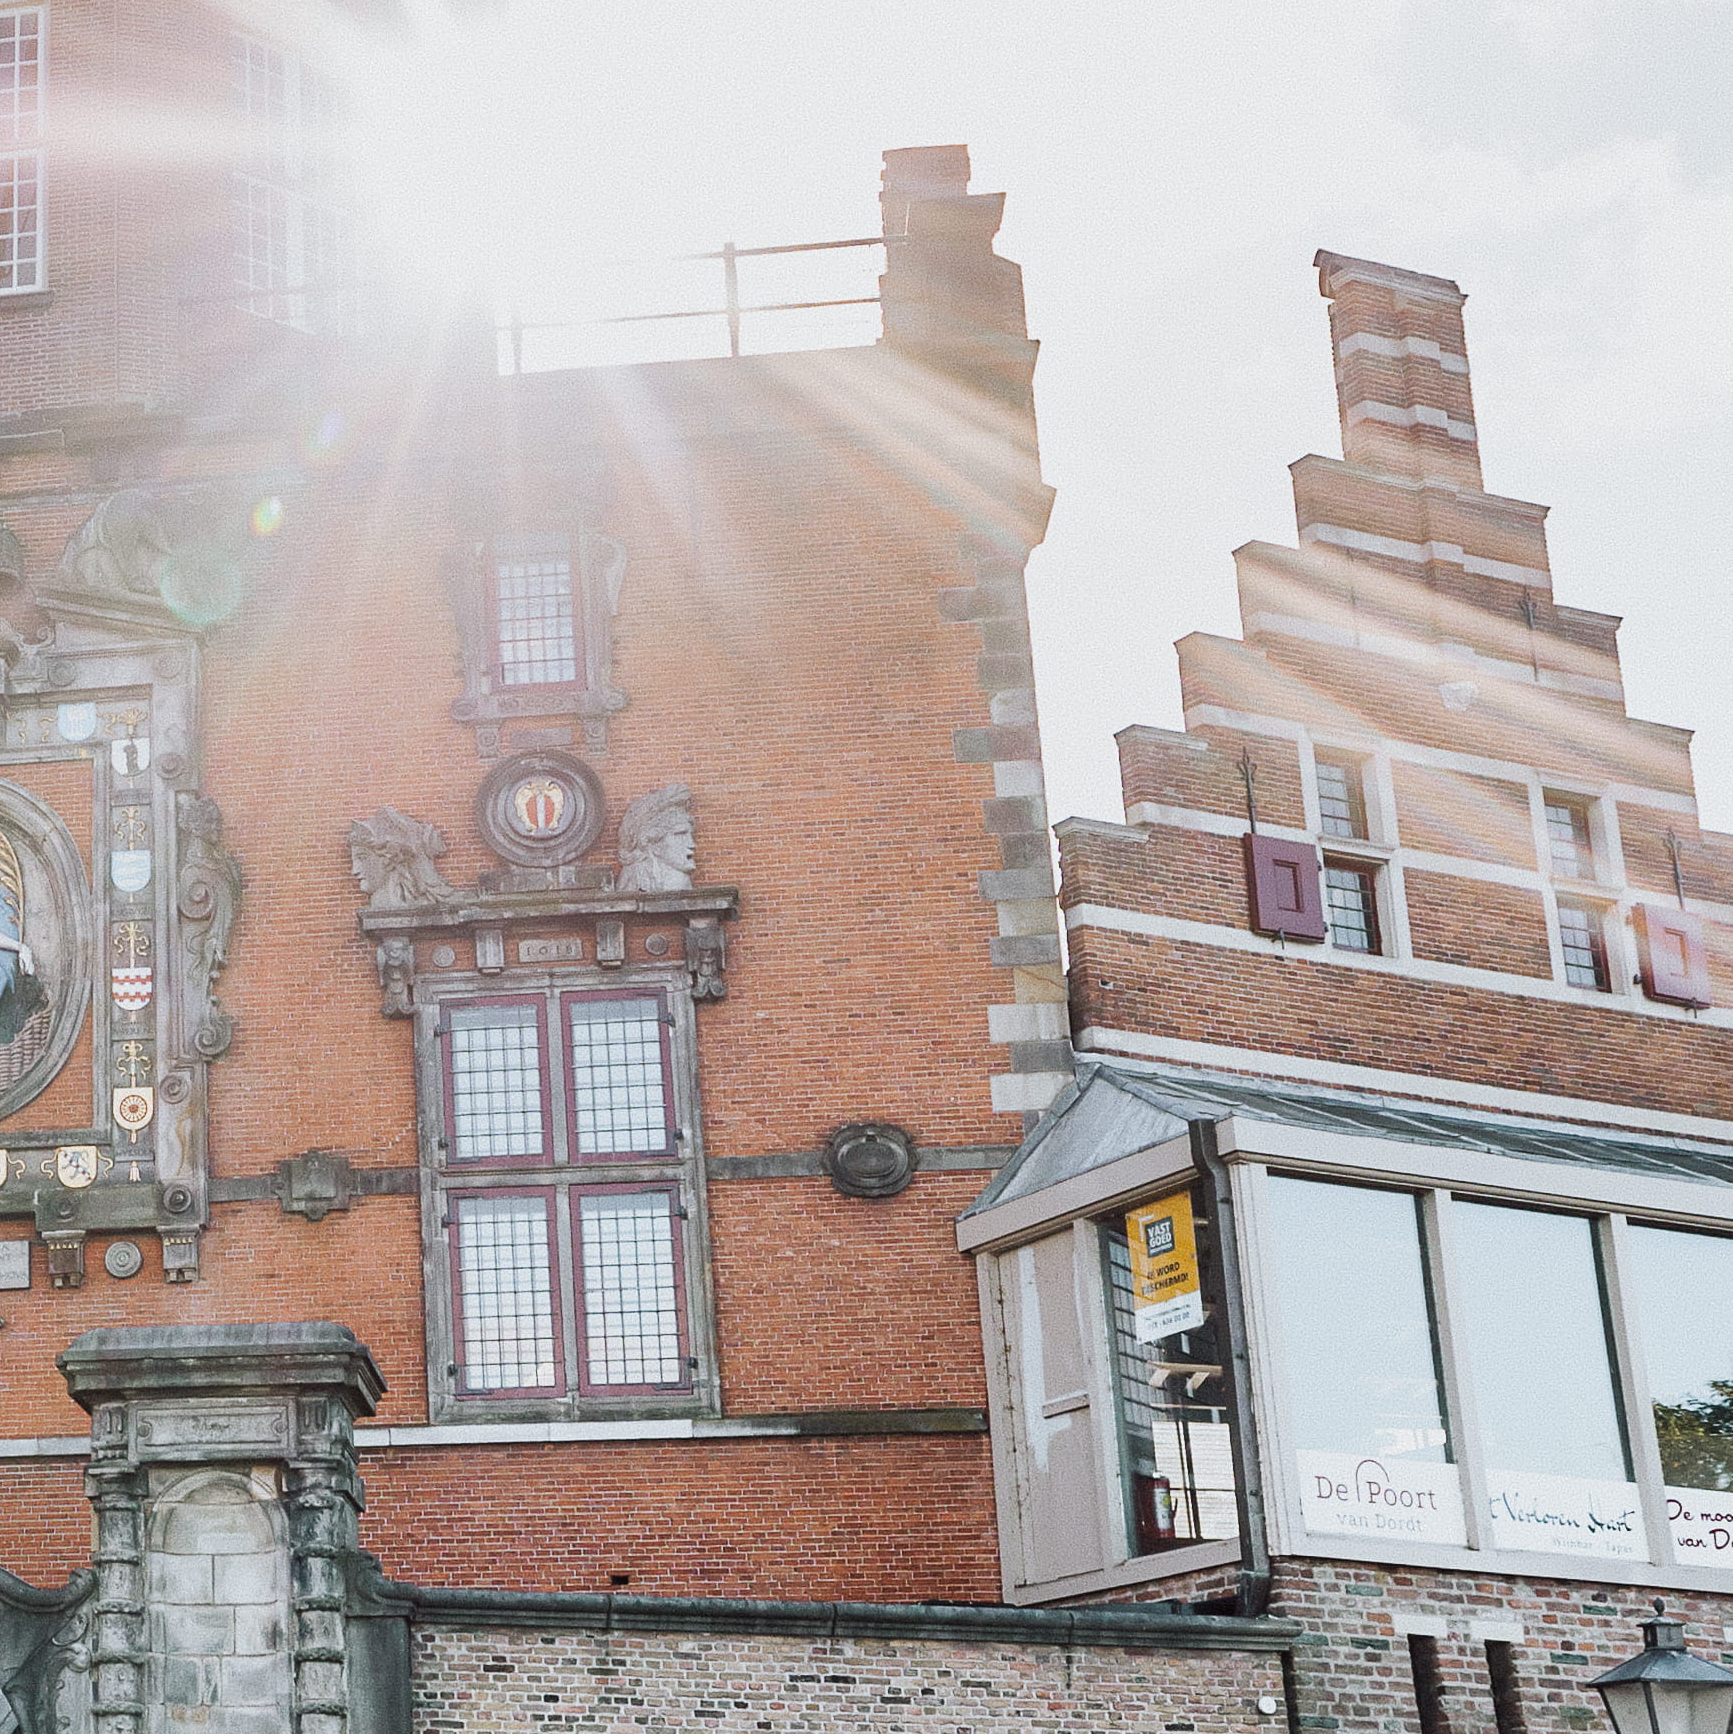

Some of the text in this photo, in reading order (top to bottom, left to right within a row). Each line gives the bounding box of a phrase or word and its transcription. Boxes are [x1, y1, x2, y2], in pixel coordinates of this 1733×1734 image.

[1148, 1221, 1171, 1238] VAST
[1150, 1233, 1172, 1248] GOED
[1157, 1261, 1181, 1277] WORD
[1314, 1475, 1437, 1511] De Poort
[1666, 1498, 1694, 1521] De
[1336, 1512, 1423, 1532] van Dordt
[1677, 1528, 1733, 1550] van D
